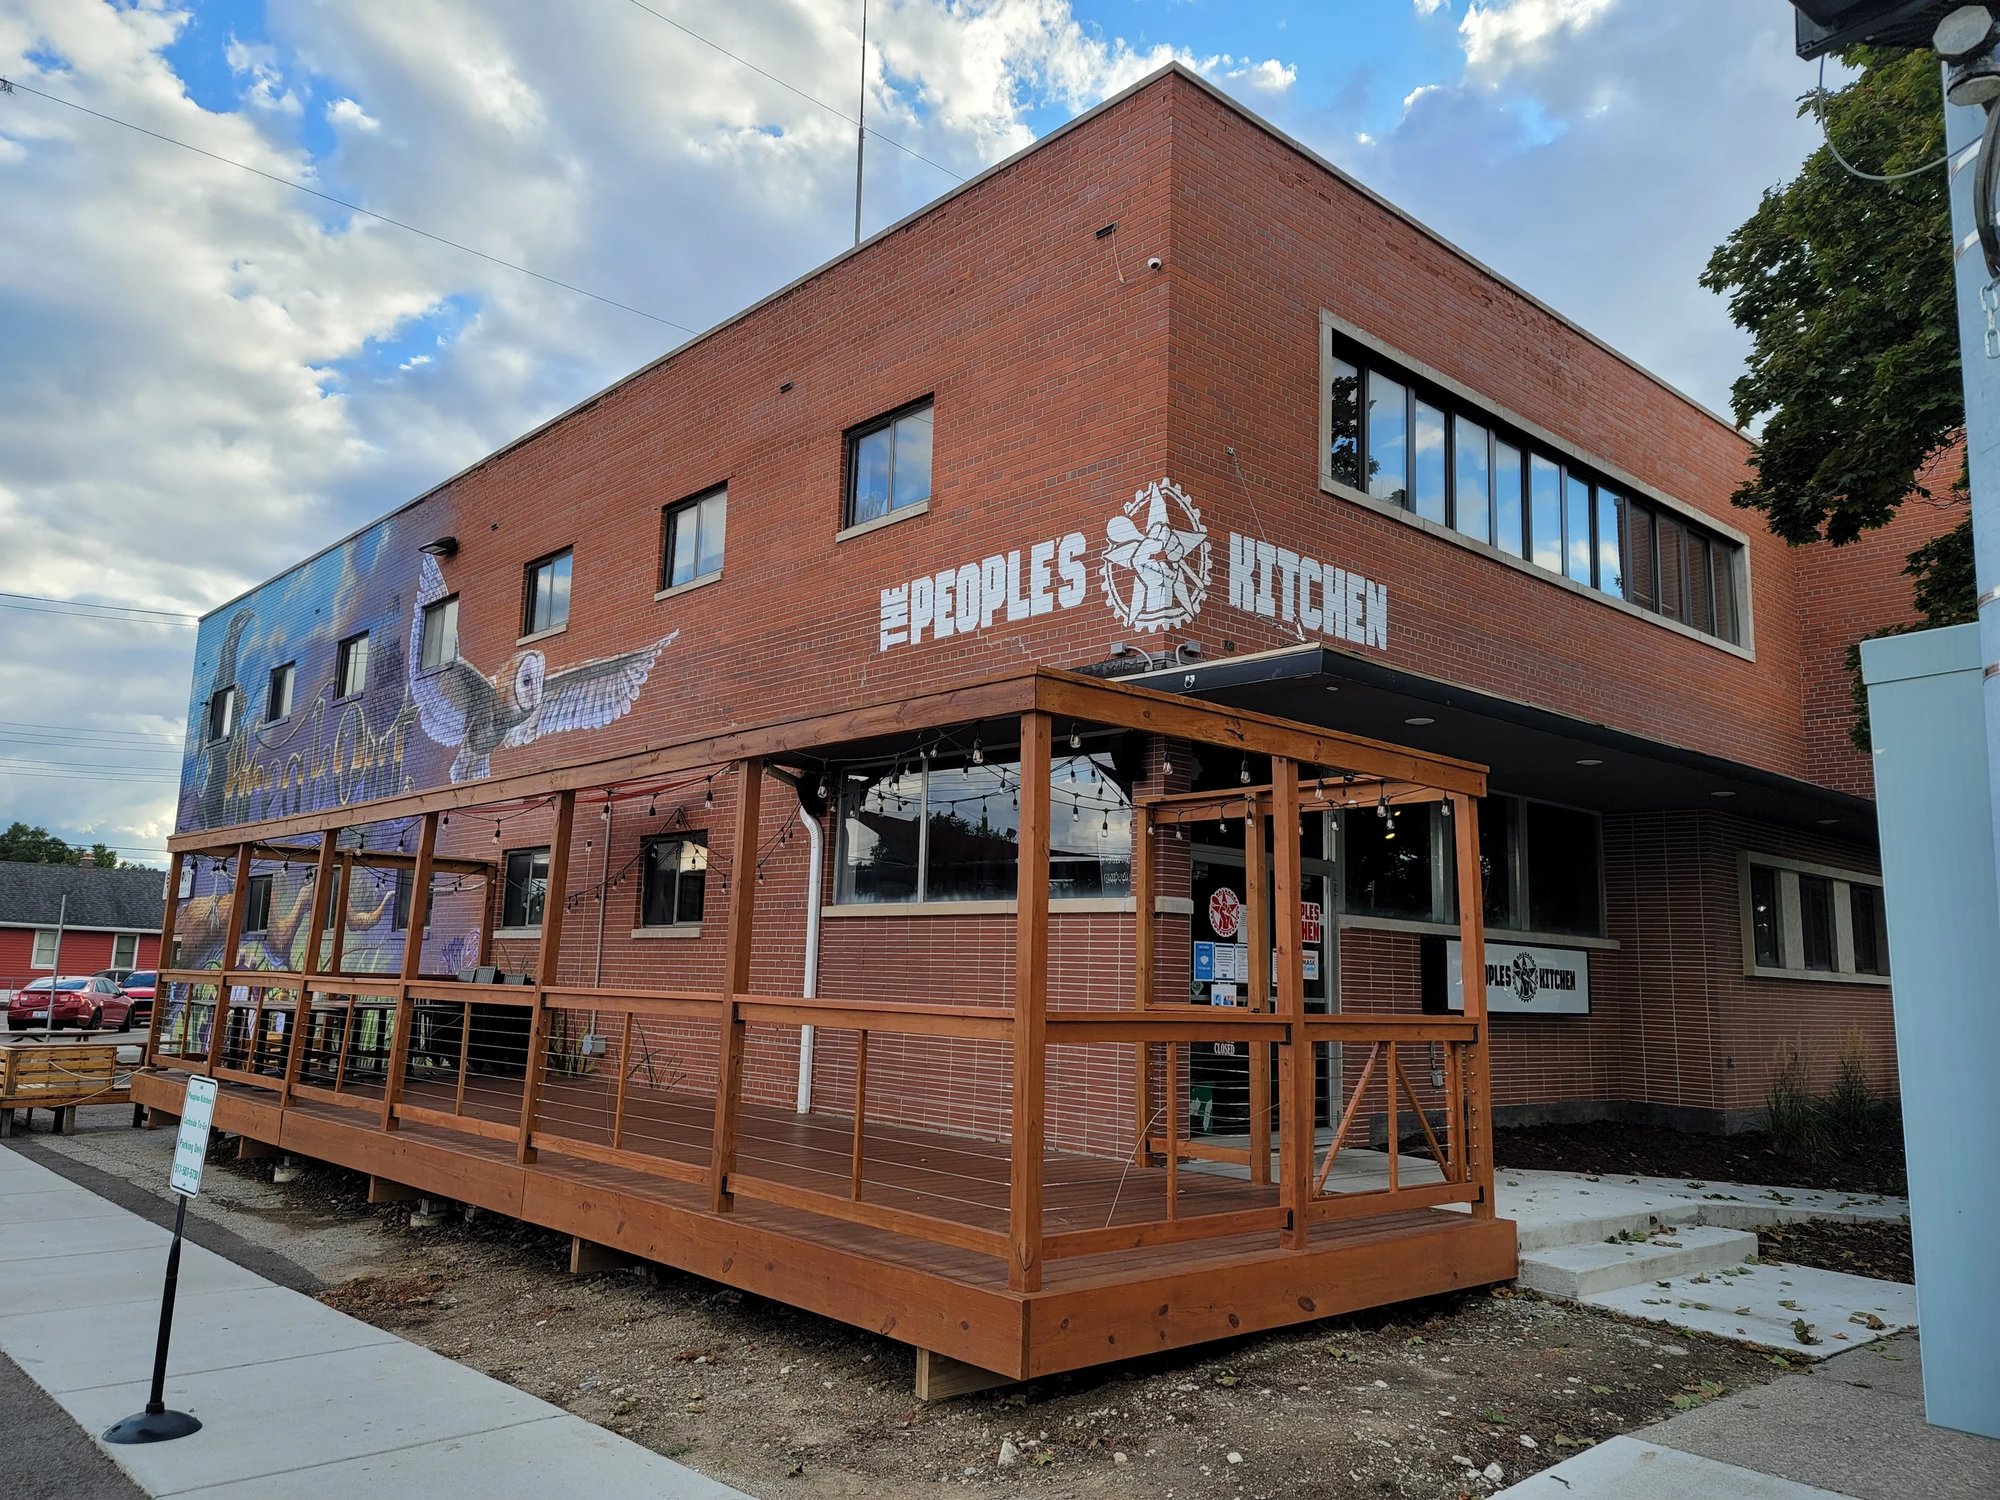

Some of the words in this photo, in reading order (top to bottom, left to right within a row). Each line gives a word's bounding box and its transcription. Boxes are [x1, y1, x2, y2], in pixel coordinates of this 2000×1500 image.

[880, 582, 909, 652] THE
[1229, 531, 1388, 651] KITCHEN
[1301, 904, 1319, 921] PLES
[1539, 967, 1576, 991] KITCHEN
[1214, 1042, 1235, 1055] CLOSED
[180, 1138, 193, 1153] Parking
